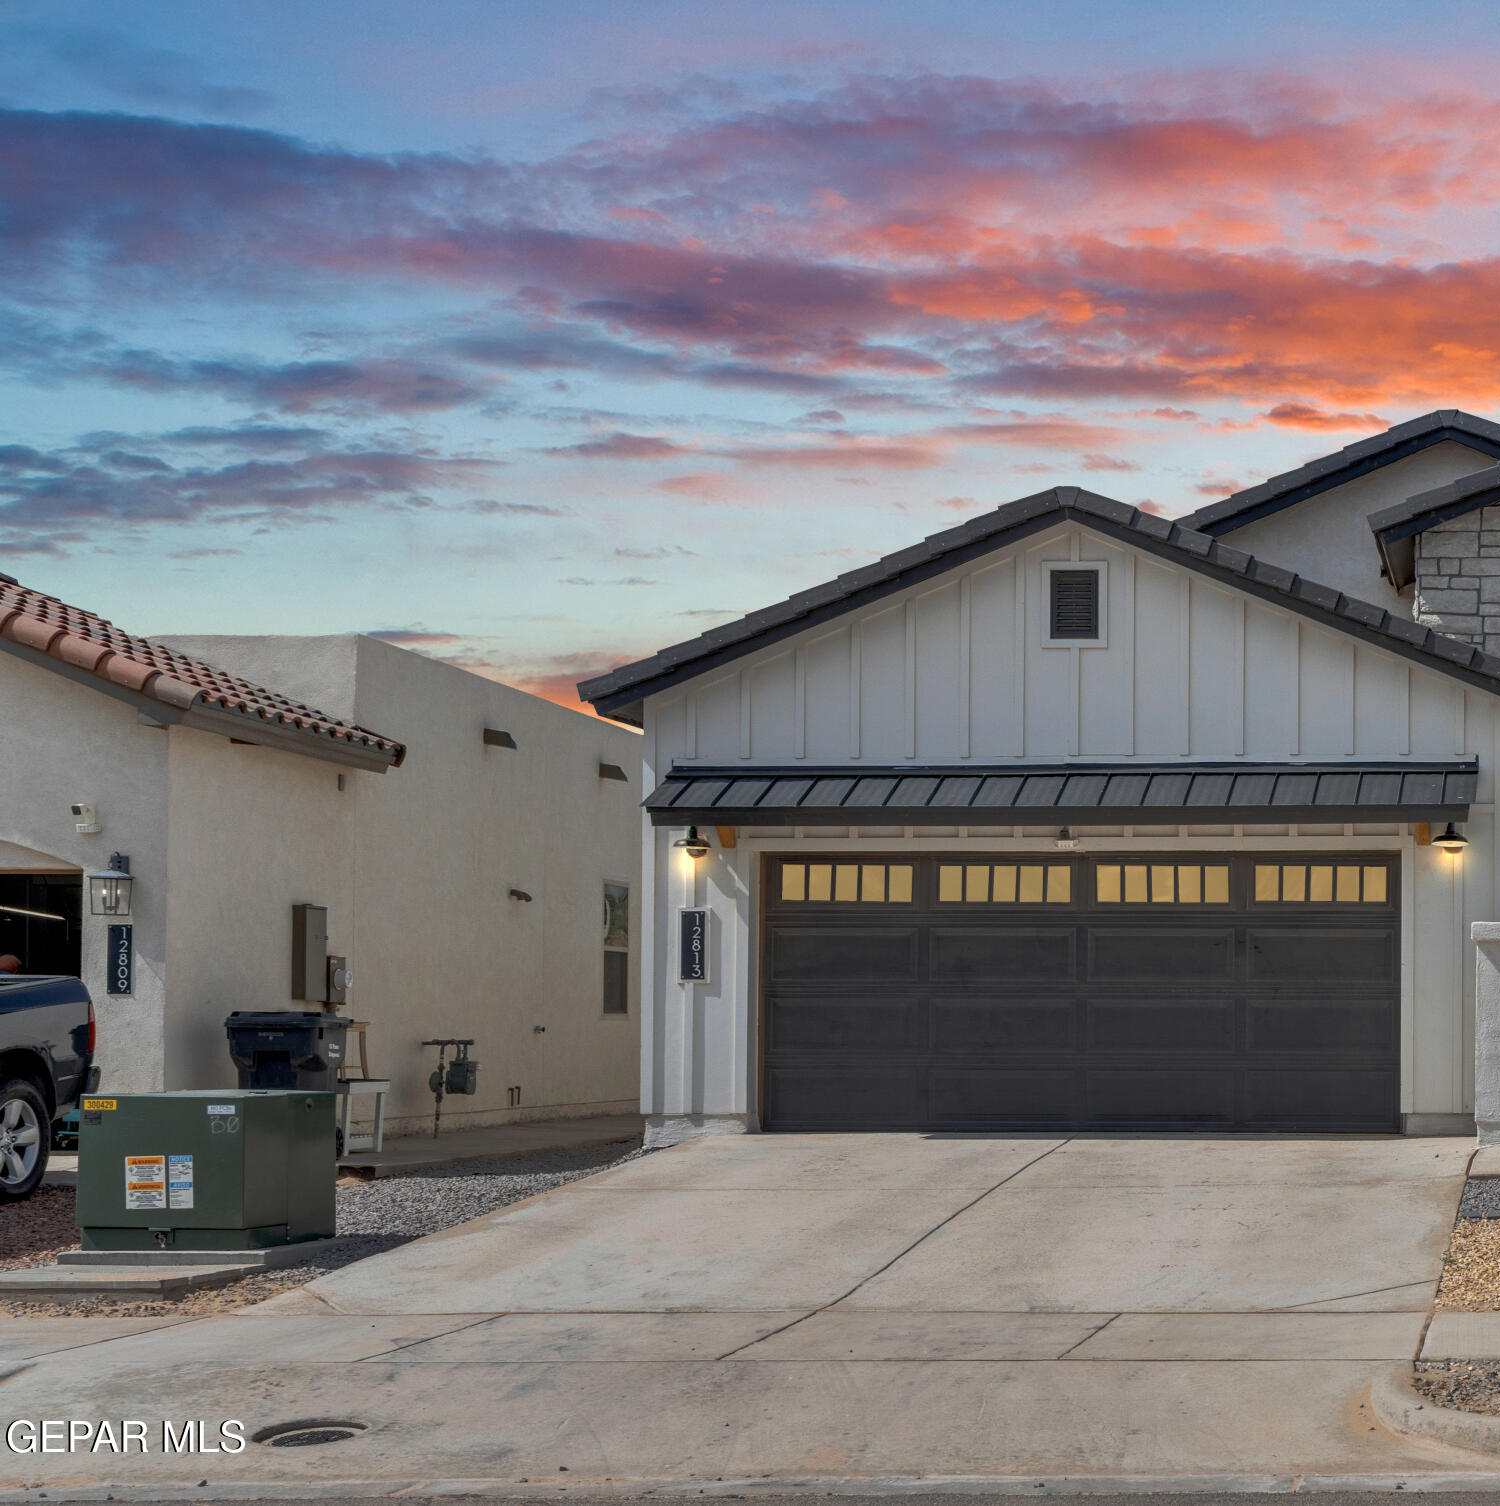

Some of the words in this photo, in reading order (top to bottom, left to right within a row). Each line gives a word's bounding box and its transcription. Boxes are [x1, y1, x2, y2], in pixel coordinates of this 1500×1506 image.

[118, 926, 129, 992] 12809
[691, 913, 701, 977] 12813
[87, 1100, 114, 1109] 300429
